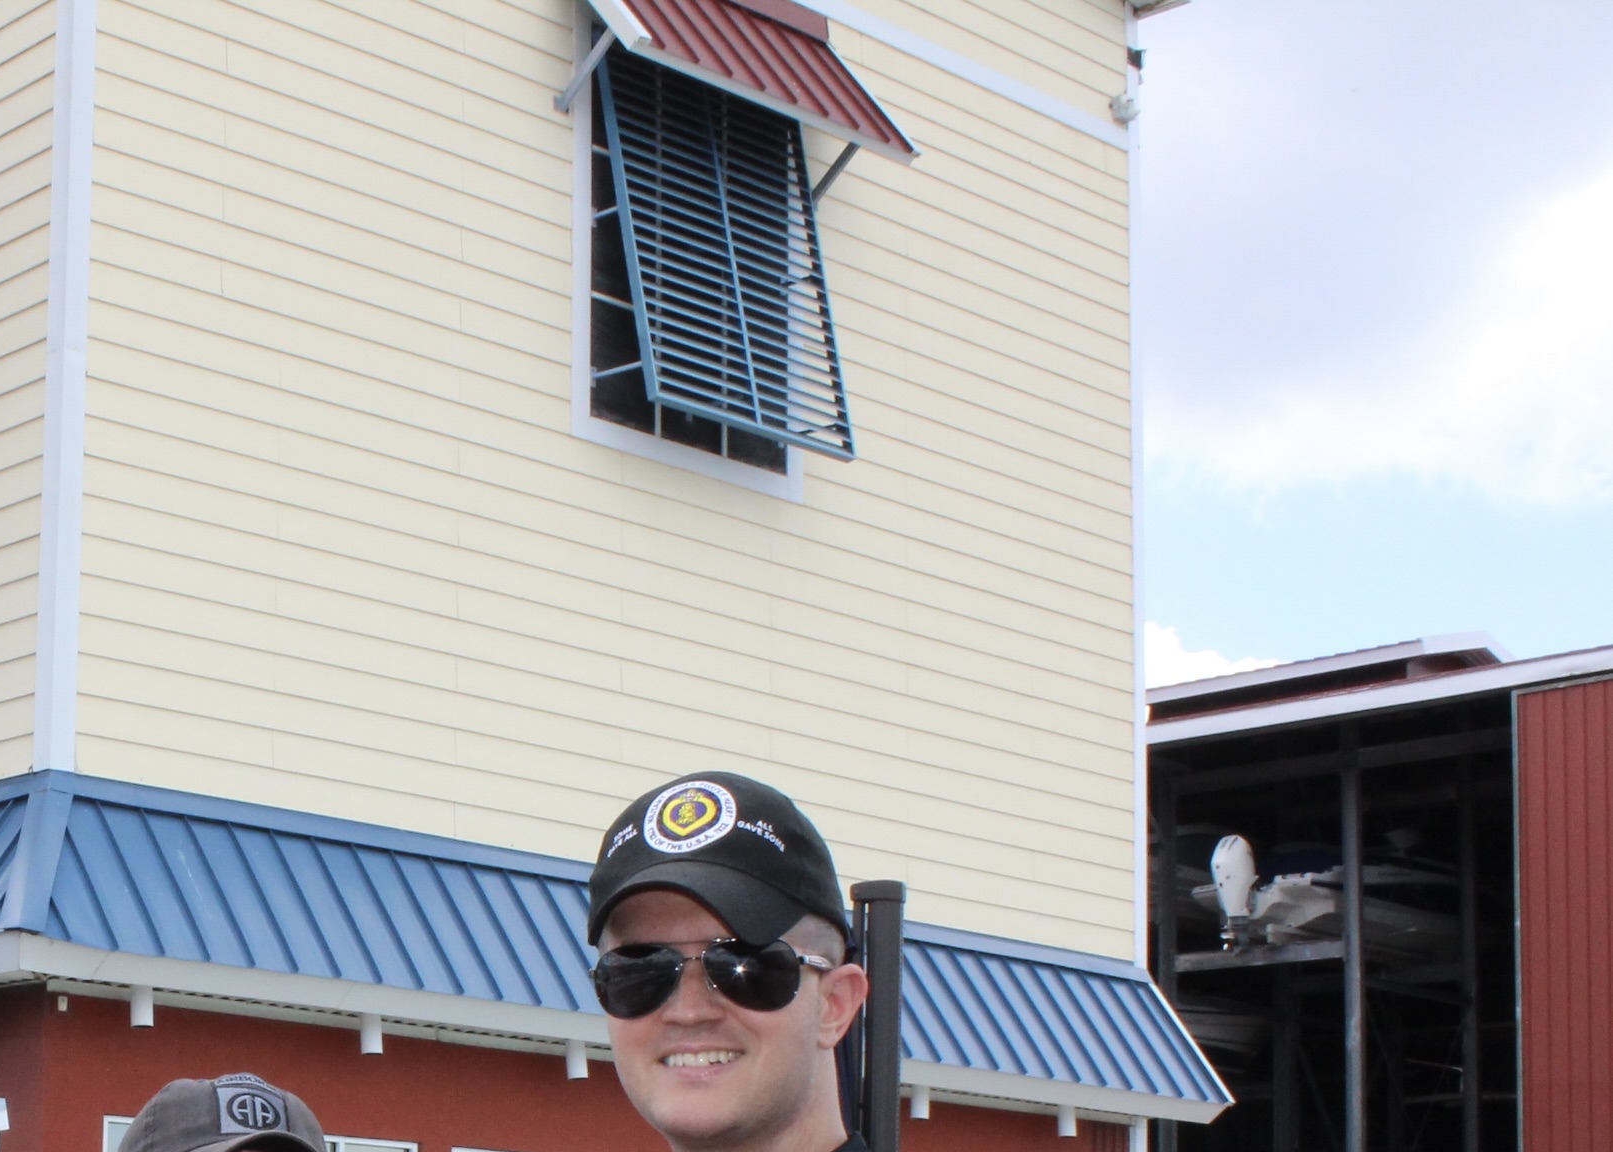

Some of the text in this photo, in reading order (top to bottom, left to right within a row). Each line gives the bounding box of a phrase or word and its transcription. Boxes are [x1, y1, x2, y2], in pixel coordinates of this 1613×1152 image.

[737, 820, 763, 836] GAVE
[756, 820, 774, 833] ALL
[667, 843, 683, 851] THE
